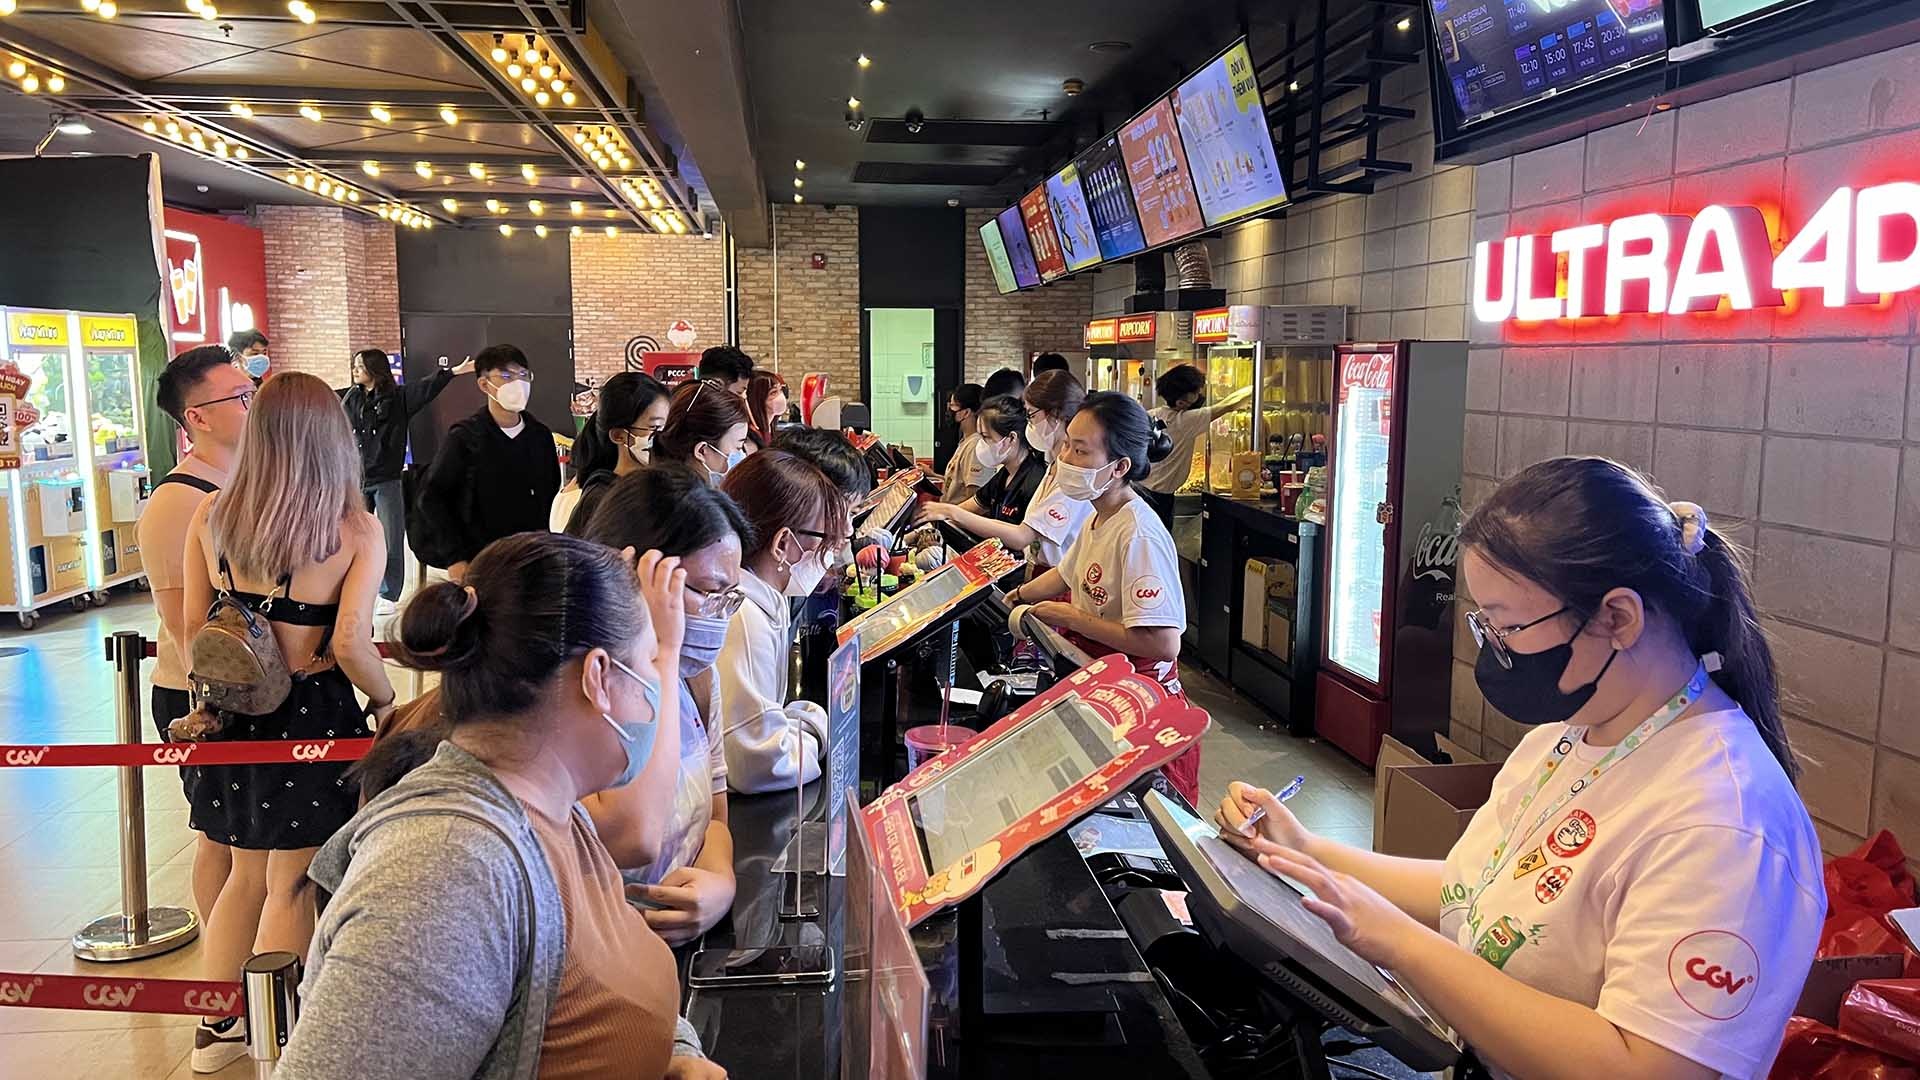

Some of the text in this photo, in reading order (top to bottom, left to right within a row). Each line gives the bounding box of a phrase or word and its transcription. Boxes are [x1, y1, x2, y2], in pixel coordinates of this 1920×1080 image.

[1507, 3, 1527, 18] 11:40
[1600, 26, 1626, 44] 20:30
[1572, 37, 1595, 55] 17:45
[1544, 48, 1567, 65] 15:00
[1520, 59, 1539, 74] 12:10
[1473, 182, 1919, 322] ULTRA 4D
[1120, 320, 1151, 337] POPCORN
[1196, 316, 1228, 335] POPCORN
[667, 369, 686, 377] PCCC
[1048, 508, 1065, 521] CGV
[1136, 589, 1160, 599] CGV
[1155, 726, 1187, 748] CGV
[5, 748, 46, 765] CGV
[153, 745, 193, 764] CGV
[292, 743, 332, 760] CGV
[1491, 928, 1508, 946] MILO
[1686, 957, 1748, 995] CGV
[83, 983, 138, 1007] CGV
[184, 989, 238, 1012] CGV
